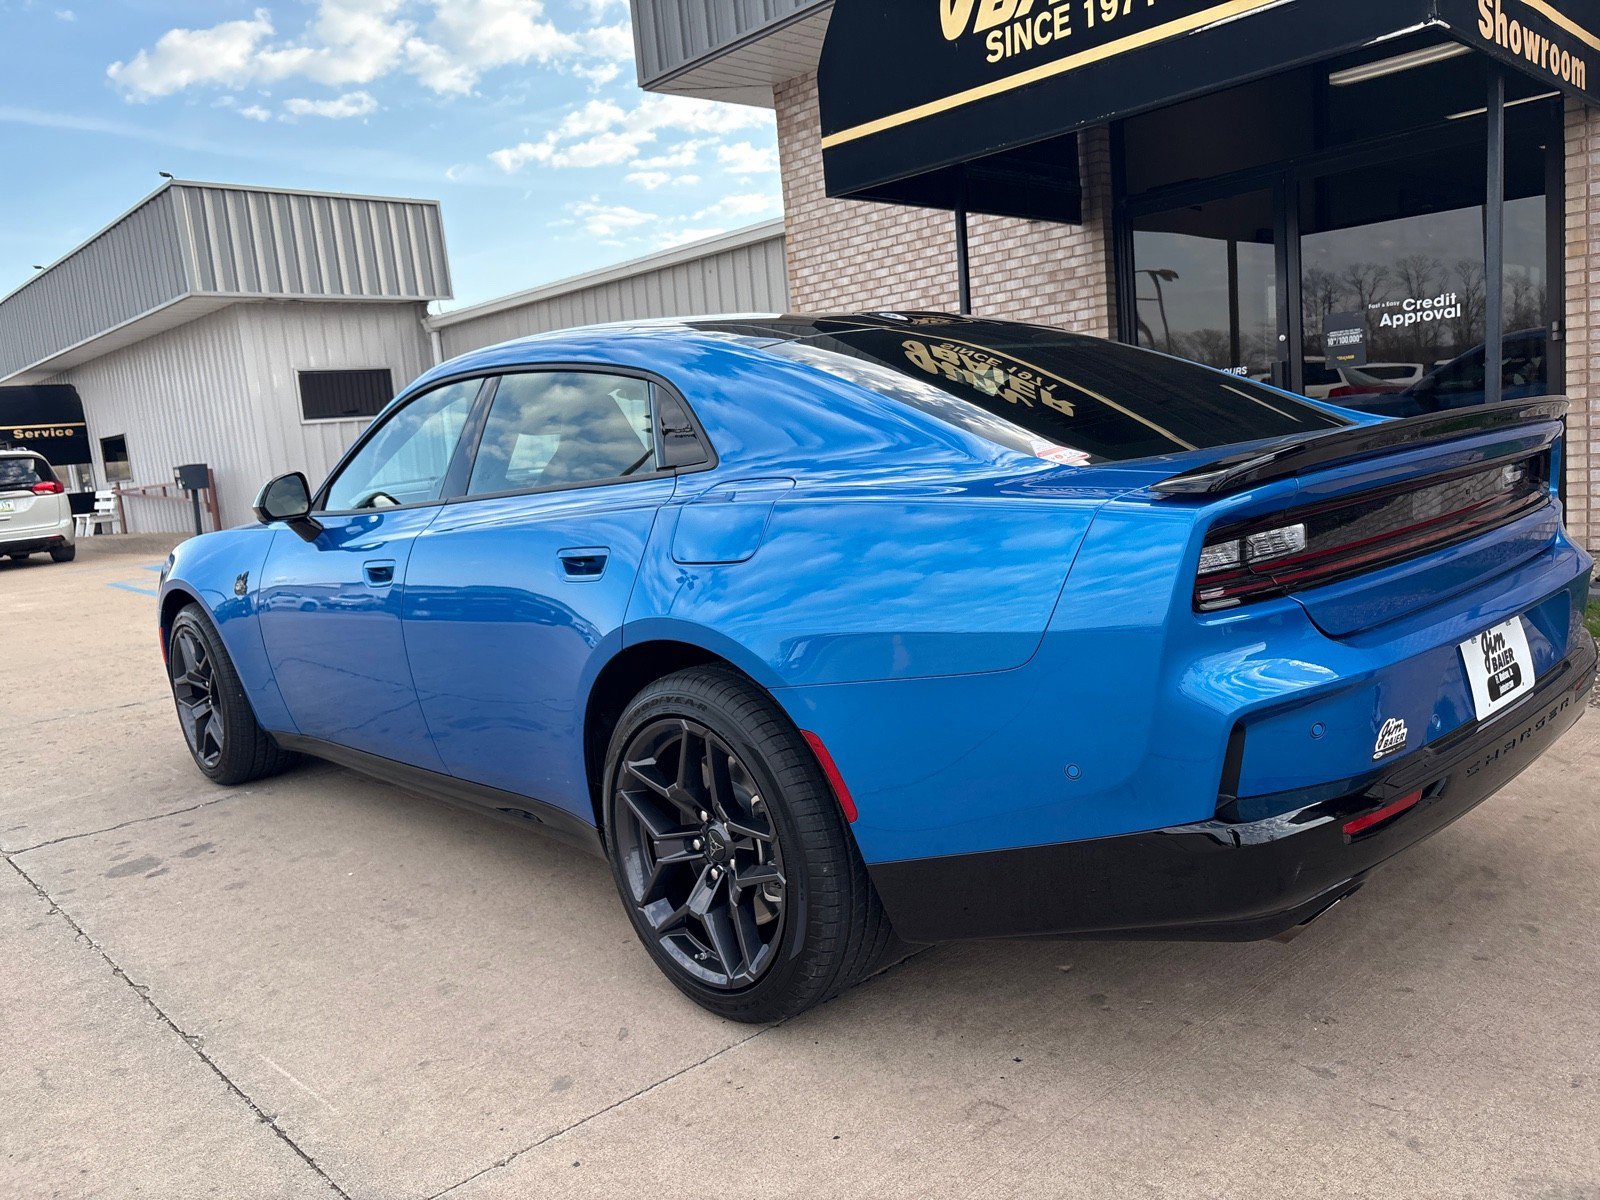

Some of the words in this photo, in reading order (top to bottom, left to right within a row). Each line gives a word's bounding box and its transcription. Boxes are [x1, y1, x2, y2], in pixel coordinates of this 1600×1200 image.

[986, 4, 1072, 63] SINCE
[1083, 0, 1155, 28] 197
[1478, 0, 1586, 91] Showroom
[1368, 302, 1381, 310] Fast
[1386, 300, 1400, 308] Easy
[1402, 292, 1457, 311] Credit
[1379, 303, 1461, 328] Approval
[1220, 366, 1248, 376] OURS
[13, 428, 74, 439] Service
[1481, 629, 1506, 674] Jim
[1491, 647, 1515, 672] BAIER
[1377, 720, 1403, 750] Jim
[1383, 731, 1405, 749] BAIER
[1467, 697, 1569, 778] CHARGER
